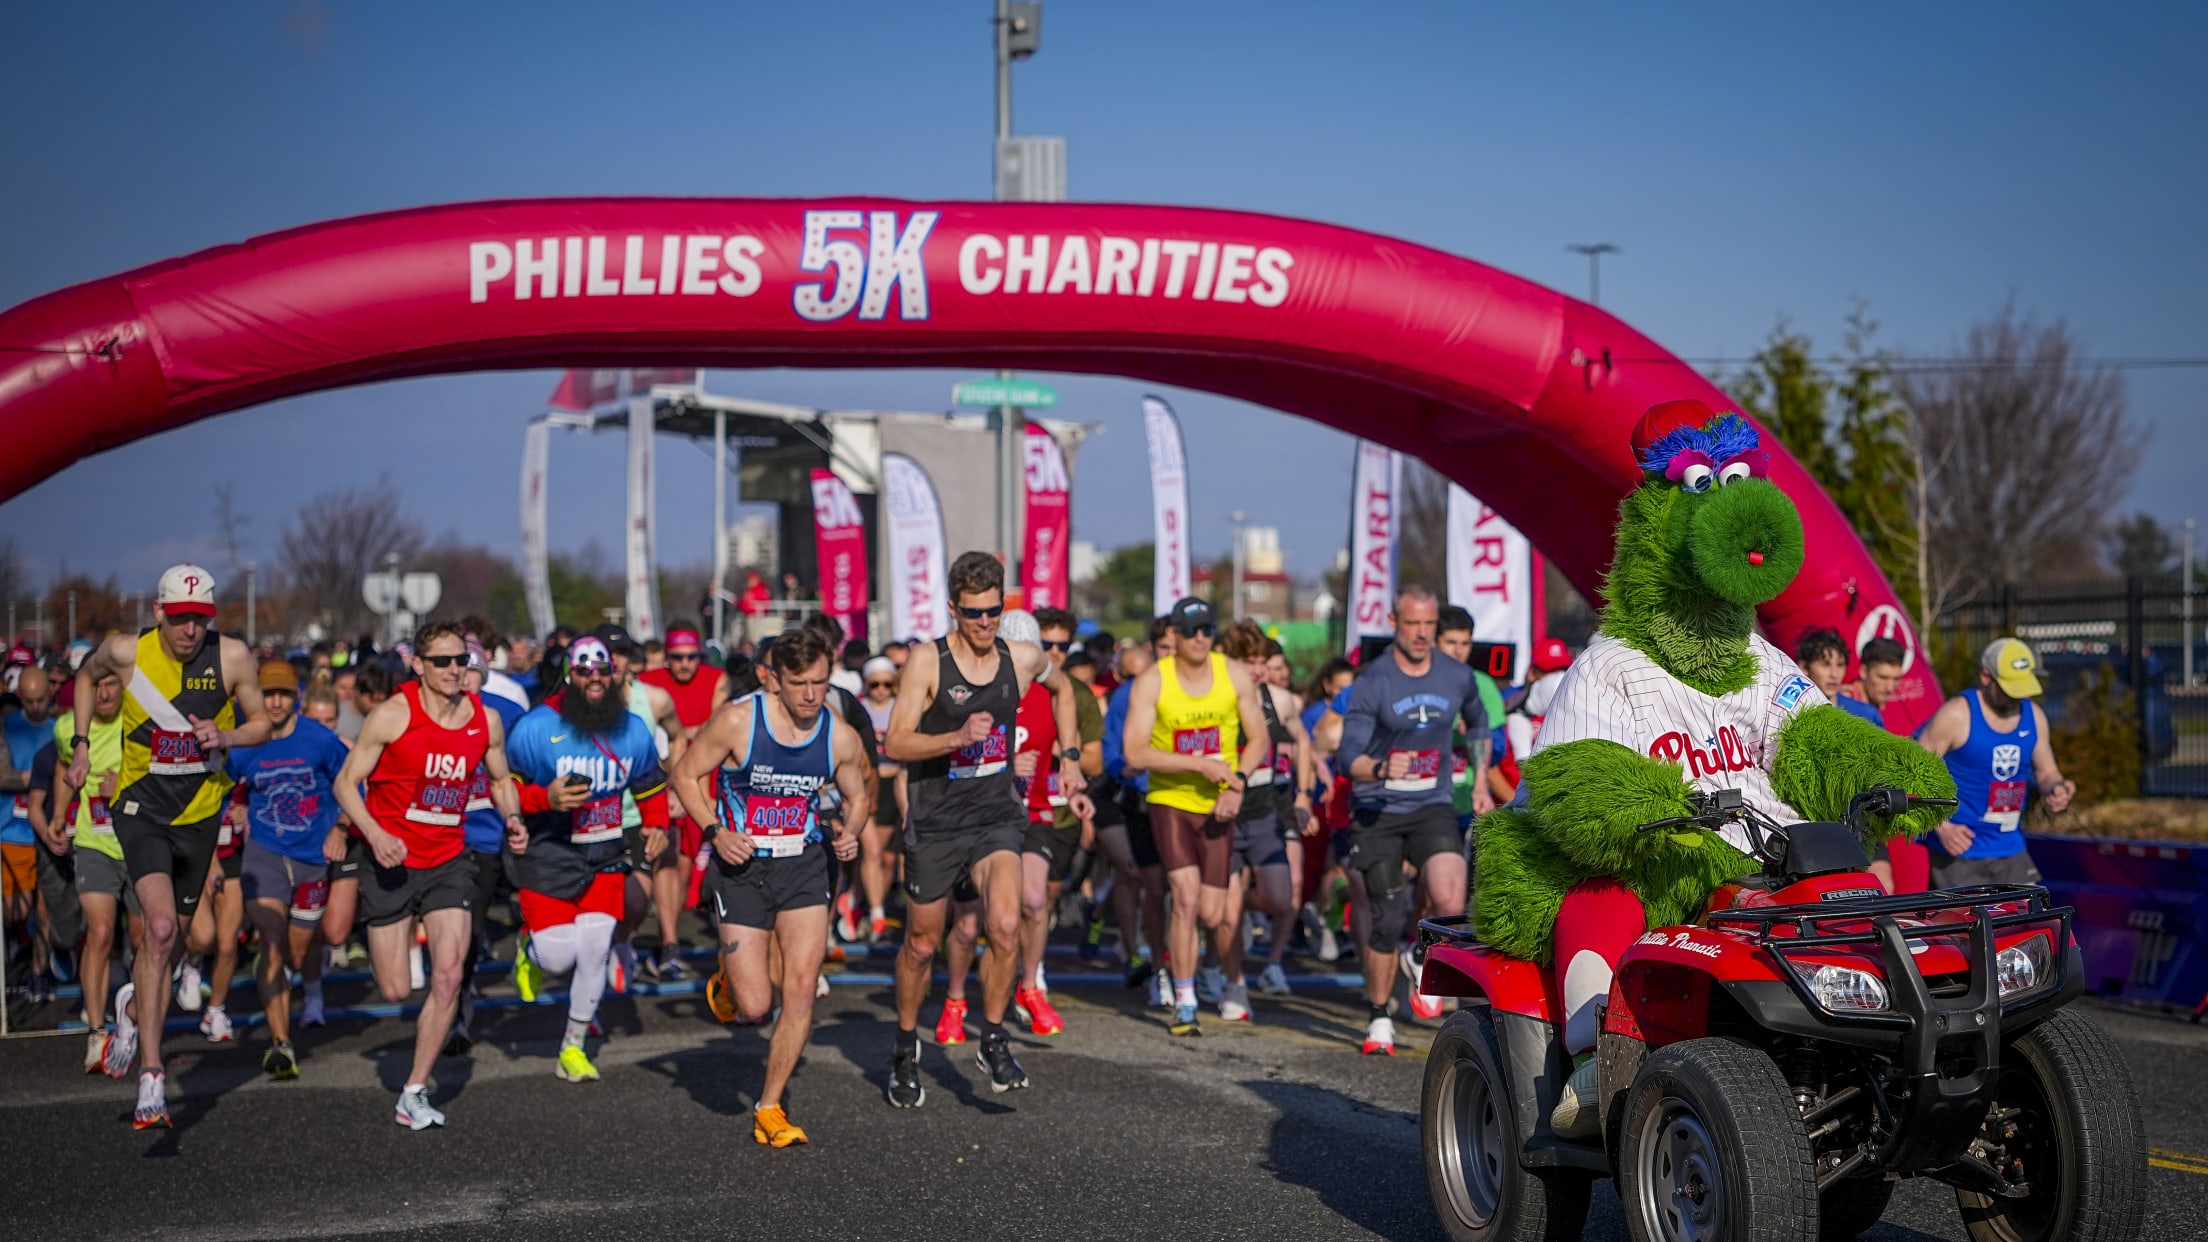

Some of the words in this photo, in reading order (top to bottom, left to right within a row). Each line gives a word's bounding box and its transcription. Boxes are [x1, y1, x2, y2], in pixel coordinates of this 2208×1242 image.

[469, 235, 764, 304] PHILLIES
[793, 209, 940, 322] 5K
[959, 234, 1294, 307] CHARITIES
[1357, 482, 1390, 628] START
[1473, 503, 1510, 605] ART
[184, 575, 199, 596] P
[907, 545, 934, 641] STAR
[1488, 645, 1510, 677] 0
[1777, 677, 1811, 710] IBX
[424, 752, 467, 782] USA
[753, 764, 774, 774] NEW
[1649, 724, 1756, 783] Phill
[752, 806, 800, 829] 4012
[1826, 888, 1880, 900] RECON
[1634, 931, 1668, 946] Phillie
[1668, 932, 1722, 958] Phanatic
